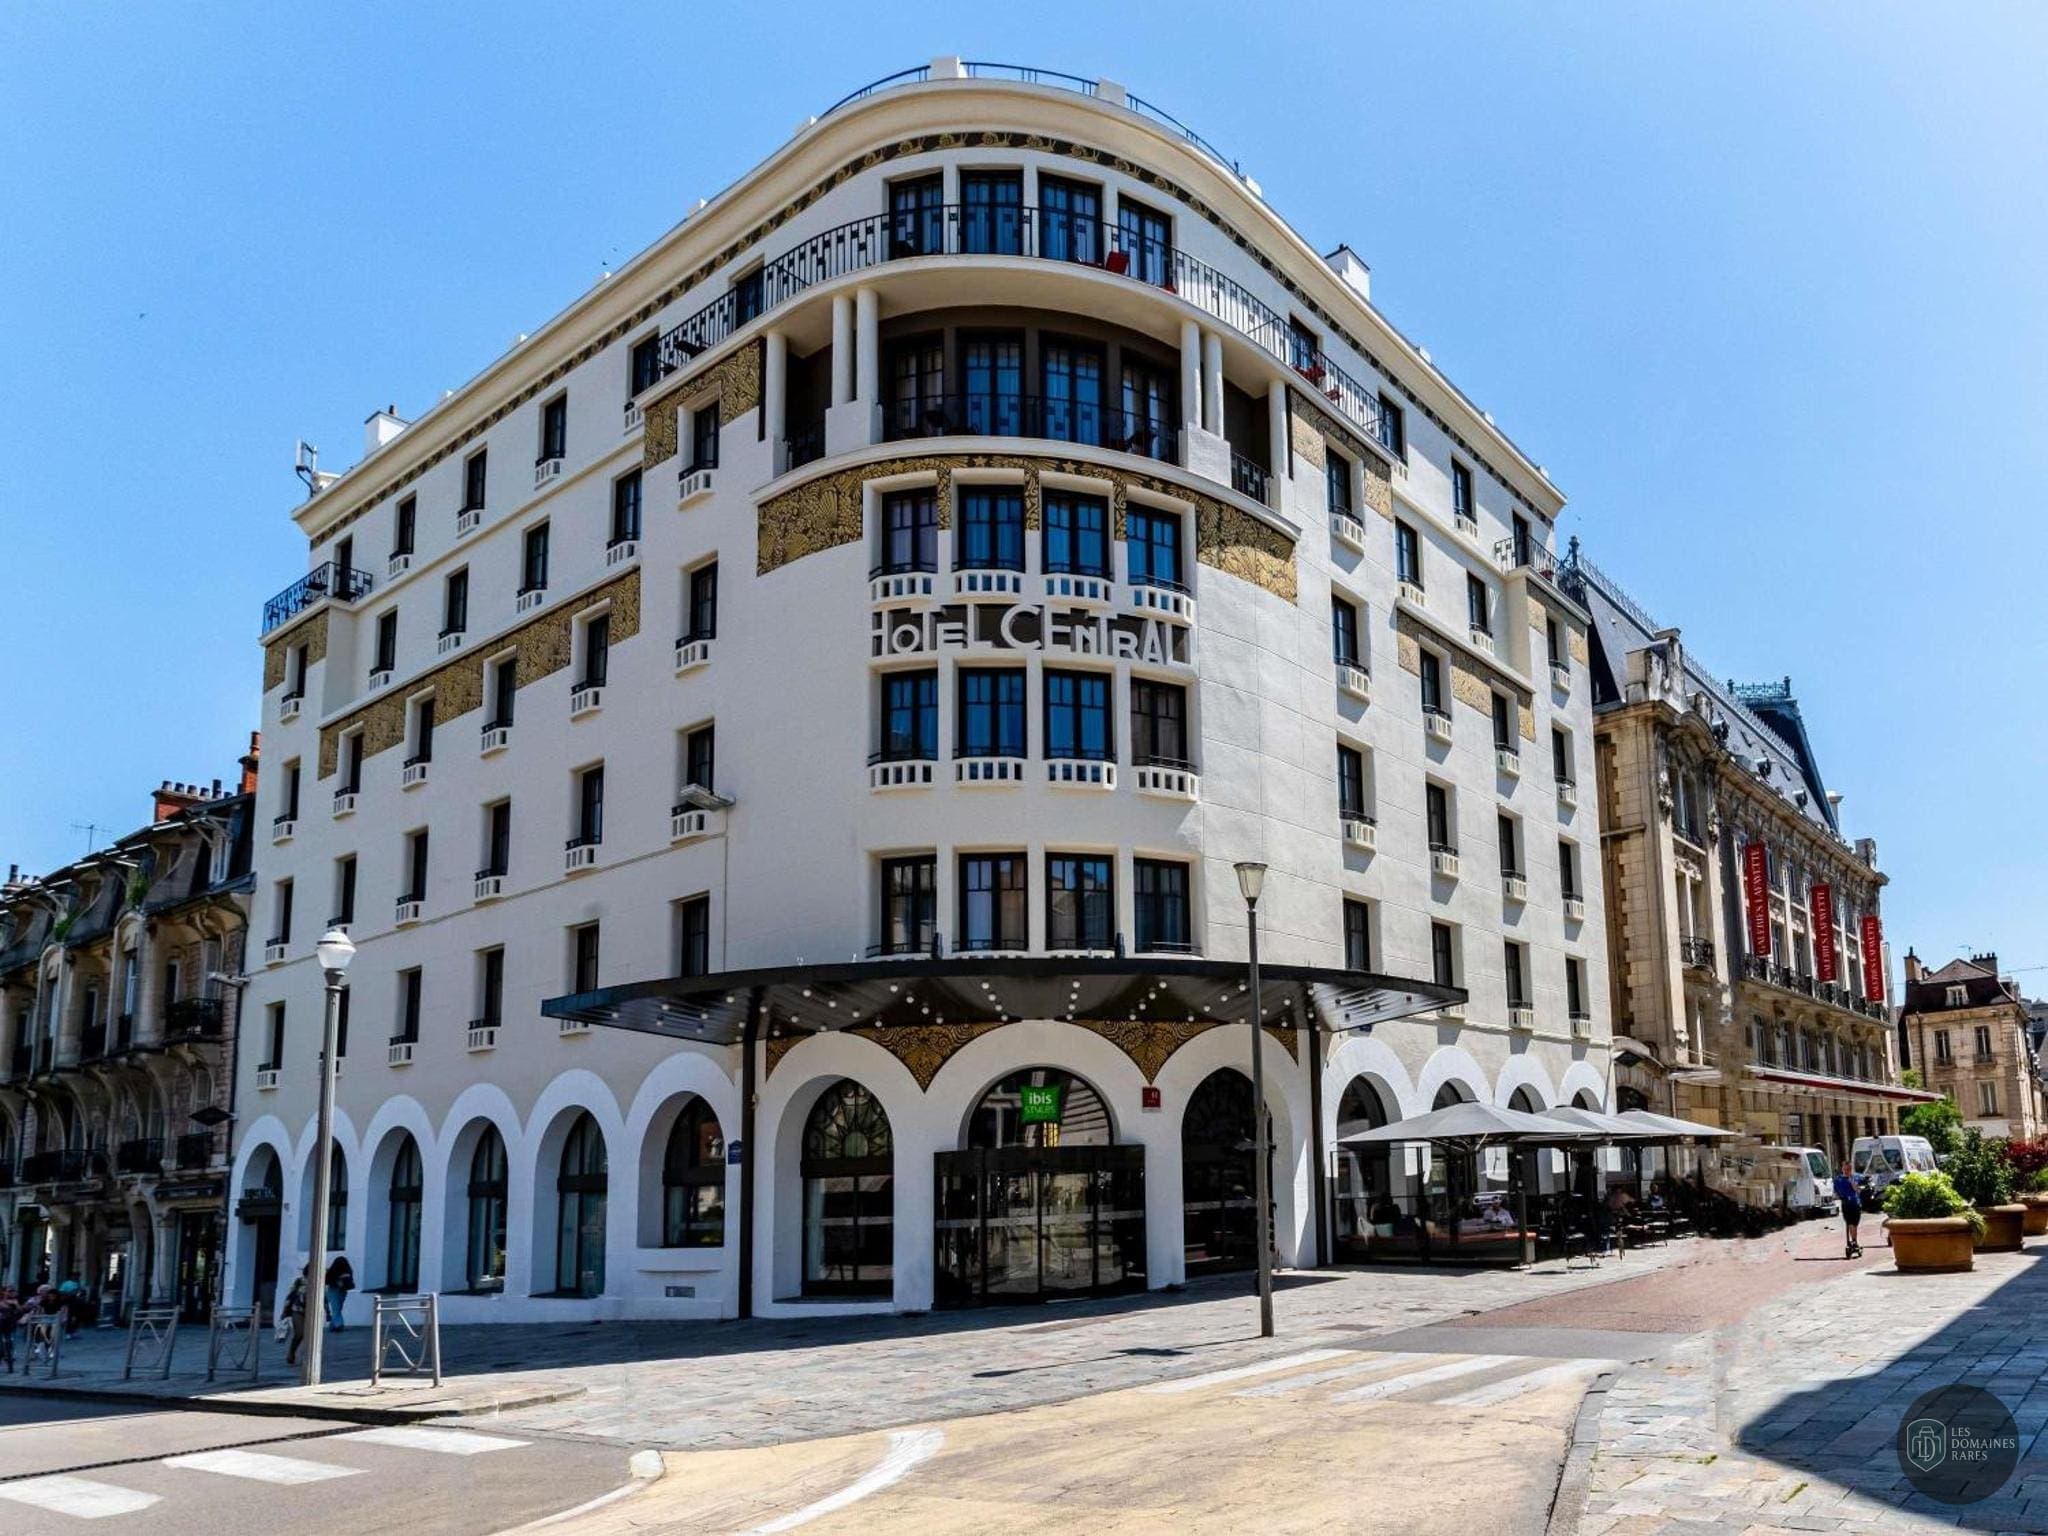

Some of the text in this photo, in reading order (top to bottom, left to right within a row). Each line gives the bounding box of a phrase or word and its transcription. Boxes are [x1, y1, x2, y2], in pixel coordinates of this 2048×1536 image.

[872, 604, 1194, 665] HOTEL CENTRAL
[1029, 1092, 1052, 1104] ibis
